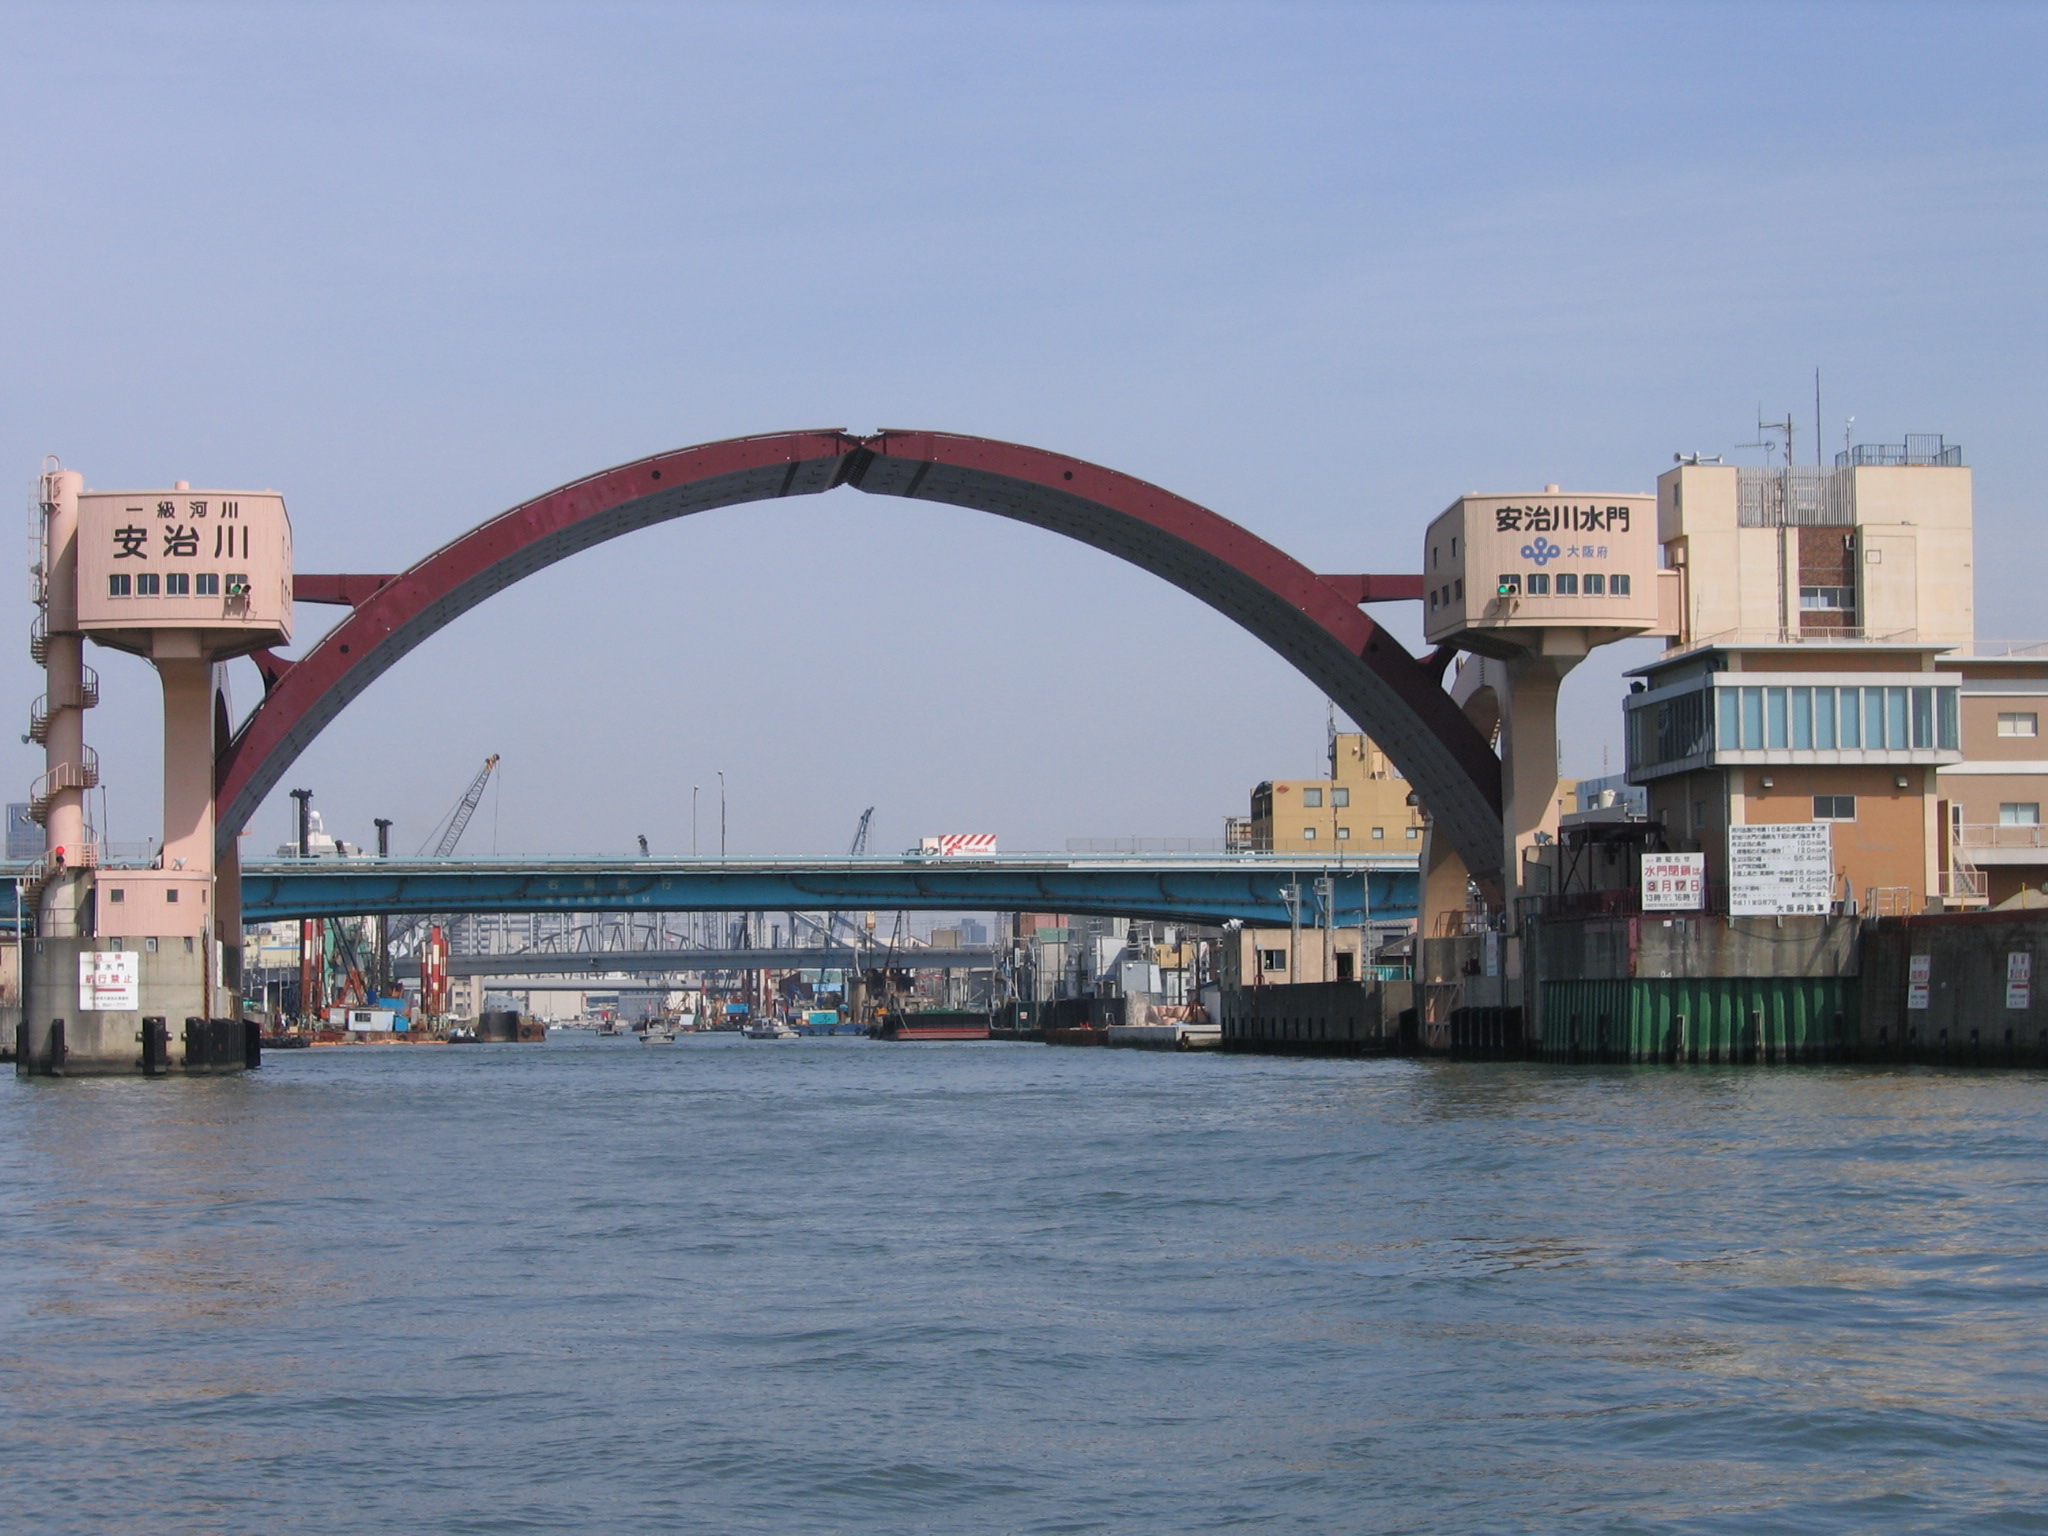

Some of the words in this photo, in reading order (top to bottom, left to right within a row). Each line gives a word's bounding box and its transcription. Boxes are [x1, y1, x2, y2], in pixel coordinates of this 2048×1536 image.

[126, 501, 238, 519] 一級河川
[1496, 505, 1630, 532] 安治川水門
[113, 524, 248, 560] 安治川
[1567, 544, 1608, 559] 大阪府
[1644, 864, 1701, 877] 水門閉鎖は
[85, 974, 132, 984] 航行禁止
